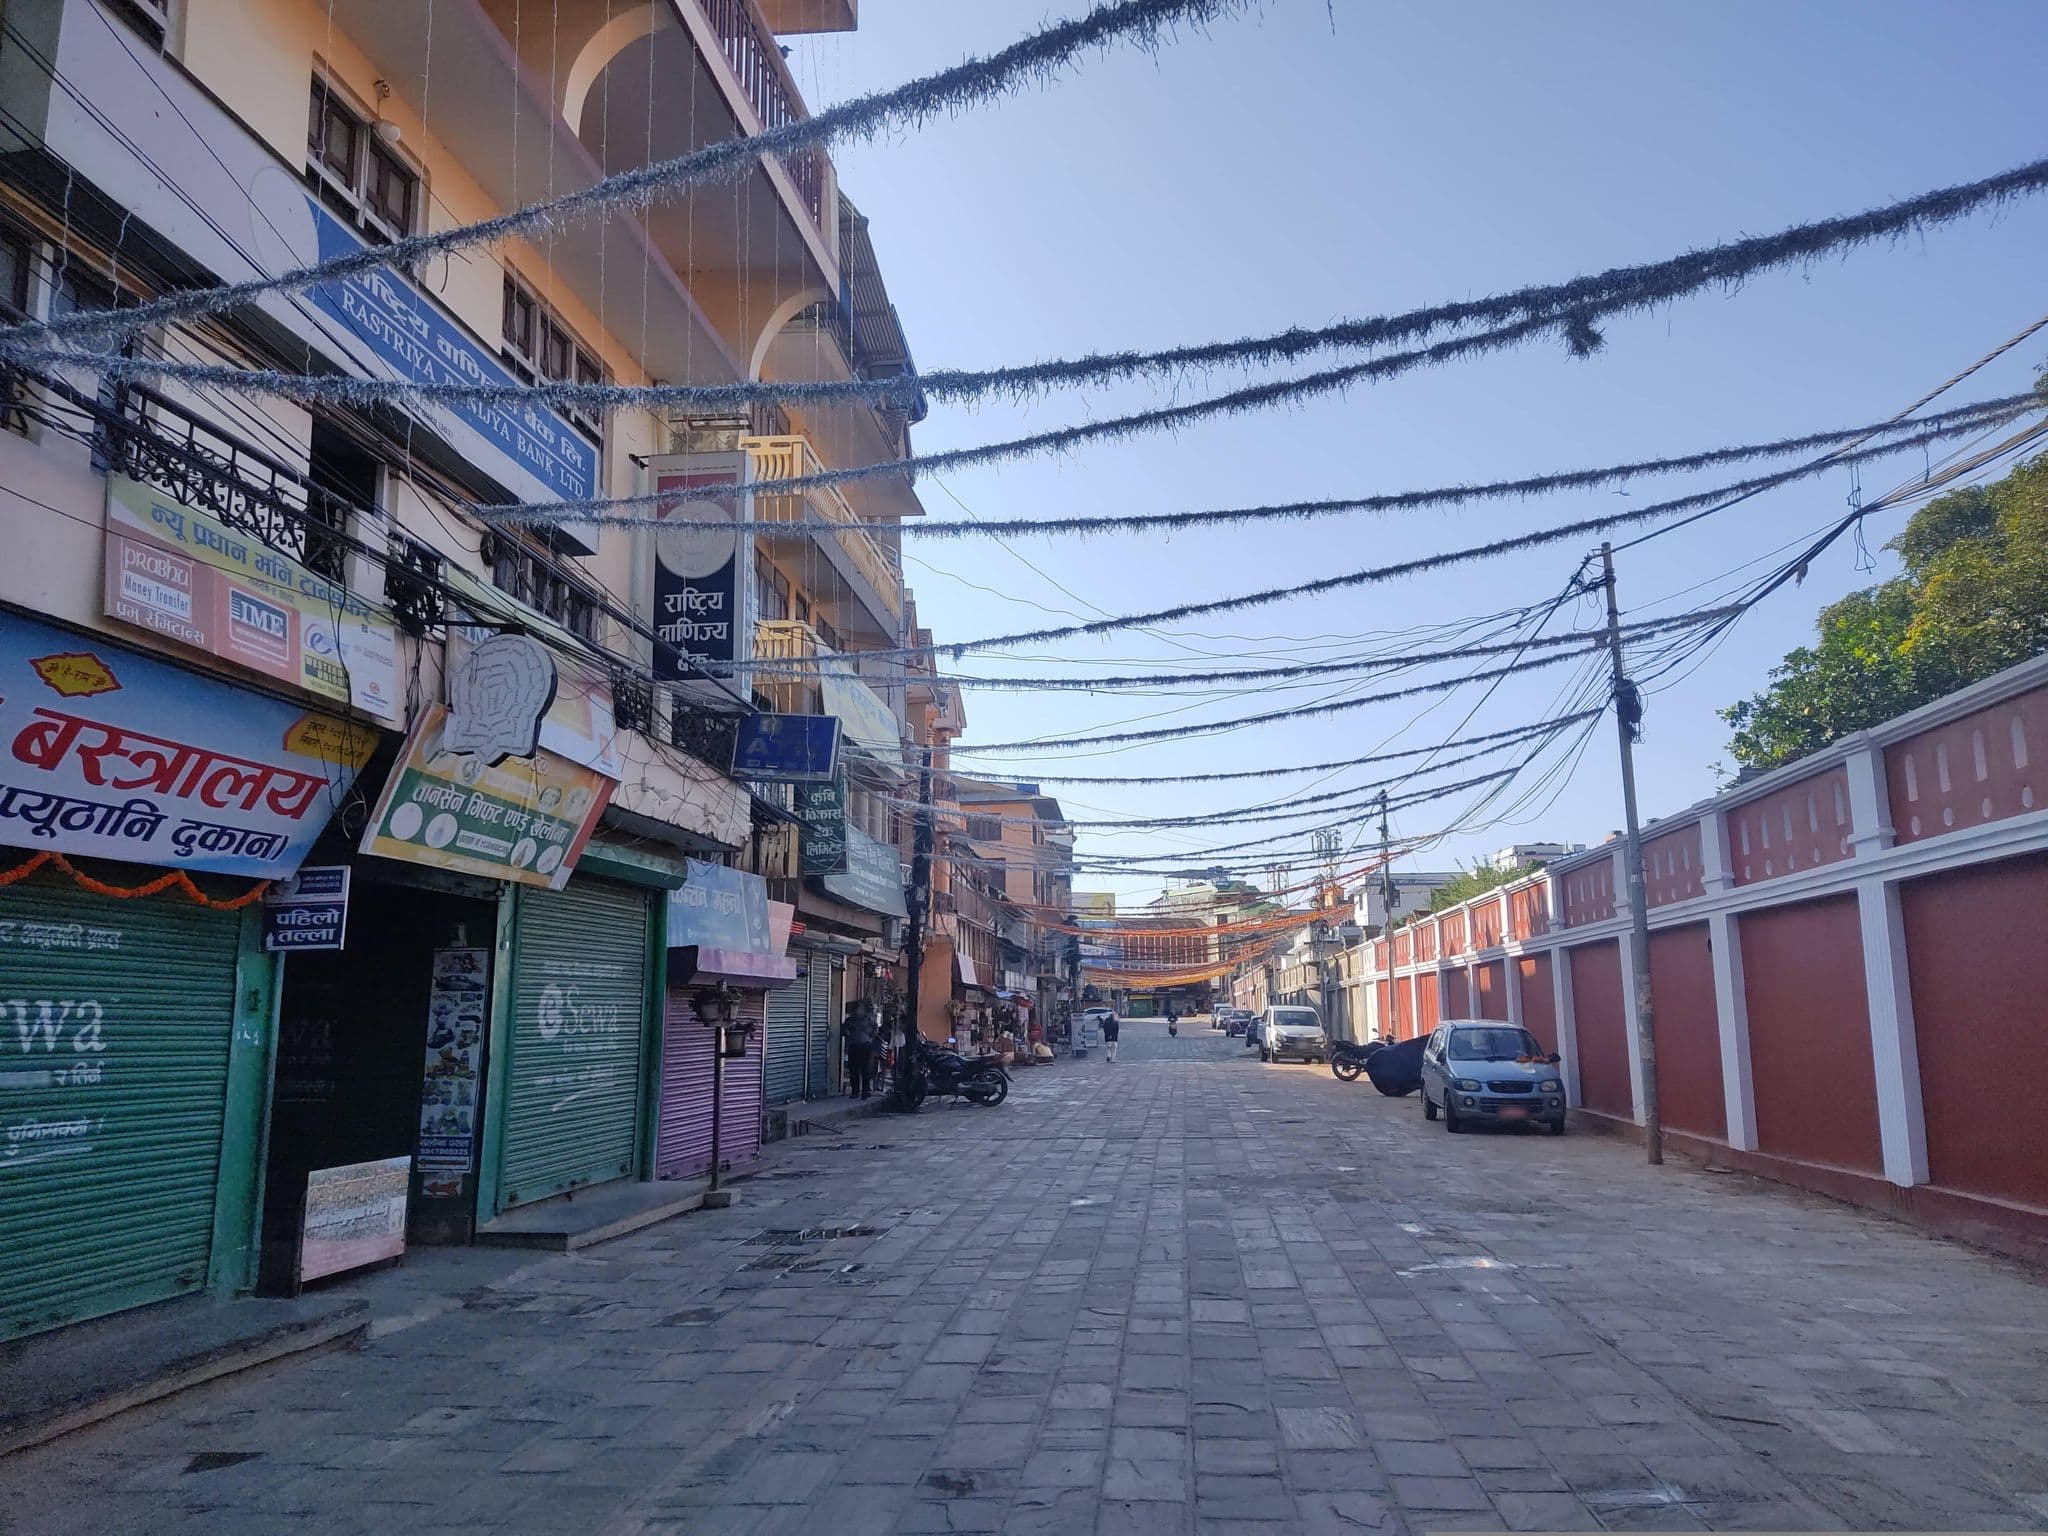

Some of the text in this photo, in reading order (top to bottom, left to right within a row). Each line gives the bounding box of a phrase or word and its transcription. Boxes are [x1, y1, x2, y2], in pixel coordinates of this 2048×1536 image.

[341, 287, 436, 382] RASTRIYA
[517, 431, 555, 477] BANK
[151, 502, 188, 543] न्यू
[193, 521, 249, 566] प्रधान
[255, 552, 293, 587] मनि
[124, 573, 189, 612] Money Transfer
[663, 587, 725, 616] राष्ट्रिय
[239, 600, 286, 640] IME
[658, 617, 729, 642] वाणिज्य
[12, 707, 330, 819] बस्त्रालय
[276, 908, 341, 926] पहिलो
[278, 928, 337, 942] तल्ला
